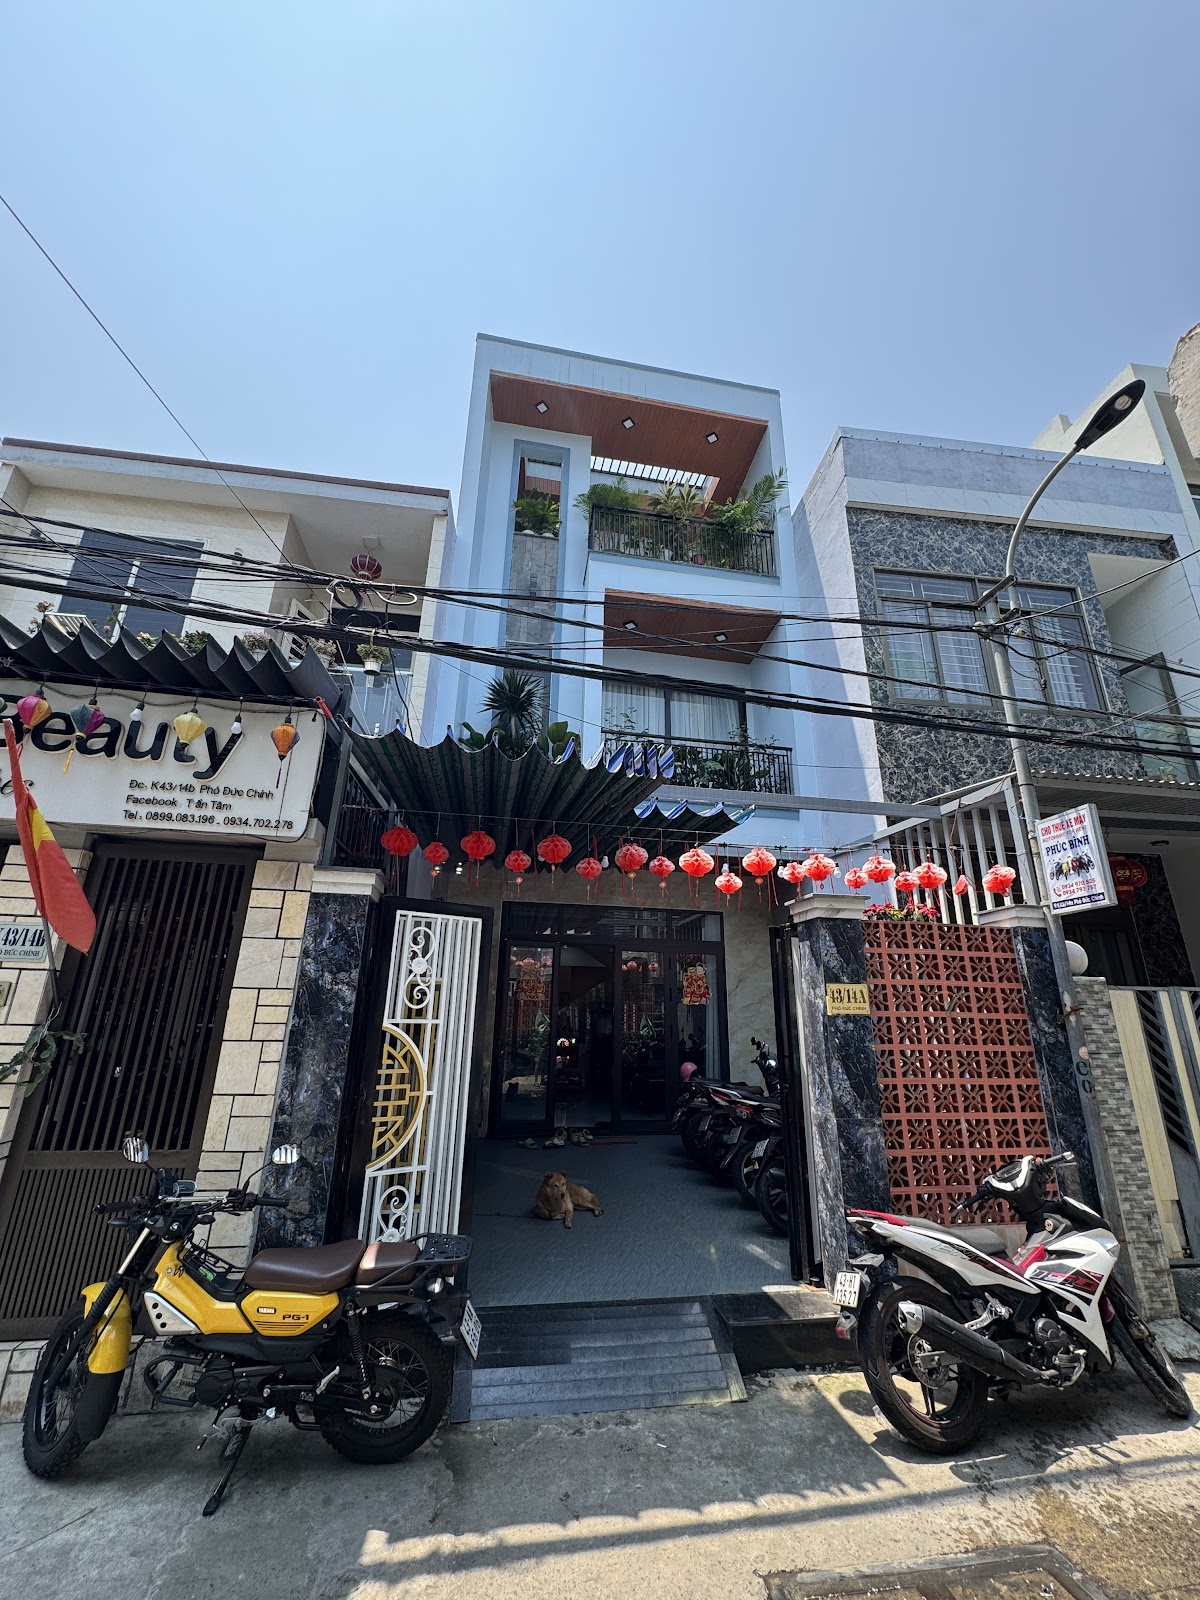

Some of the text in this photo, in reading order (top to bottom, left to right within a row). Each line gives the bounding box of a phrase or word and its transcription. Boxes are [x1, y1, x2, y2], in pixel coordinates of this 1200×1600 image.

[0, 694, 243, 779] eauty
[151, 781, 196, 793] K43/14b
[126, 794, 178, 807] Facebook
[145, 811, 215, 824] 0899.083.196
[223, 816, 294, 830] 0934.702.278
[1041, 825, 1052, 837] CHO
[1065, 818, 1073, 829] XE
[1045, 835, 1090, 857] PHÚC BÌNH
[0, 927, 46, 947] 43/14B
[830, 987, 867, 1004] 43/14A
[282, 1313, 309, 1321] PG-1
